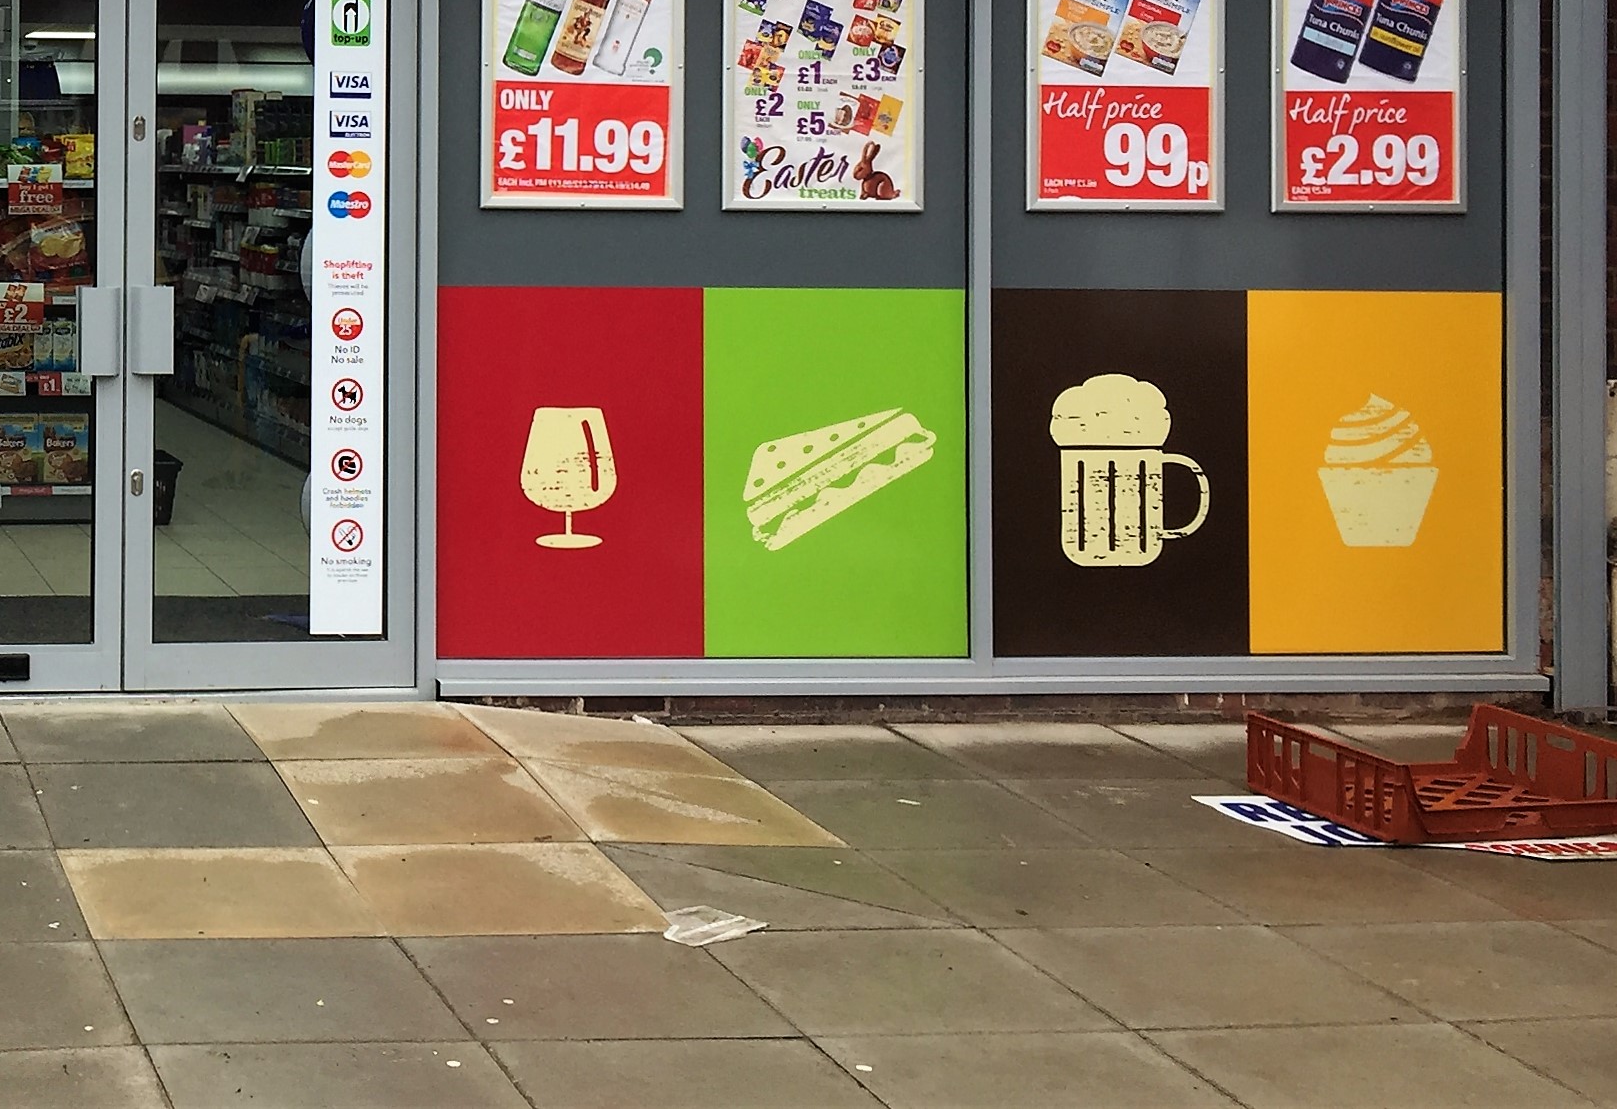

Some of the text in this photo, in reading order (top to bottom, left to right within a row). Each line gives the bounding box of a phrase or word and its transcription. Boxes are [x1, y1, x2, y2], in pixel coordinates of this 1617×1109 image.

[1308, 14, 1360, 40] Tuna Chunks
[1376, 12, 1428, 40] Tuna Chunks
[334, 33, 368, 44] top-up
[852, 48, 876, 56] ONLY
[798, 61, 822, 84] £1
[852, 58, 881, 82] £3
[334, 76, 369, 88] VISA
[745, 86, 768, 96] ONLY
[500, 89, 552, 110] ONLY
[756, 93, 784, 116] £2
[797, 100, 820, 110] ONLY
[1043, 88, 1162, 130] Half price
[1290, 93, 1408, 136] Half price
[334, 115, 369, 128] VISA
[796, 112, 825, 135] £5
[499, 118, 664, 174] £11.99
[1104, 122, 1209, 194] 99p
[1300, 134, 1440, 186] £2.99
[329, 161, 370, 169] MasterCard
[742, 146, 850, 200] Easter
[497, 177, 517, 186] EACH
[19, 190, 54, 203] free
[798, 187, 856, 200] treats
[330, 199, 369, 210] Maestro
[324, 260, 373, 271] Shoplifting
[4, 304, 28, 323] £2
[339, 324, 352, 335] 25
[329, 415, 367, 426] No dogs
[46, 439, 75, 448] Bakers
[336, 557, 372, 566] smoking
